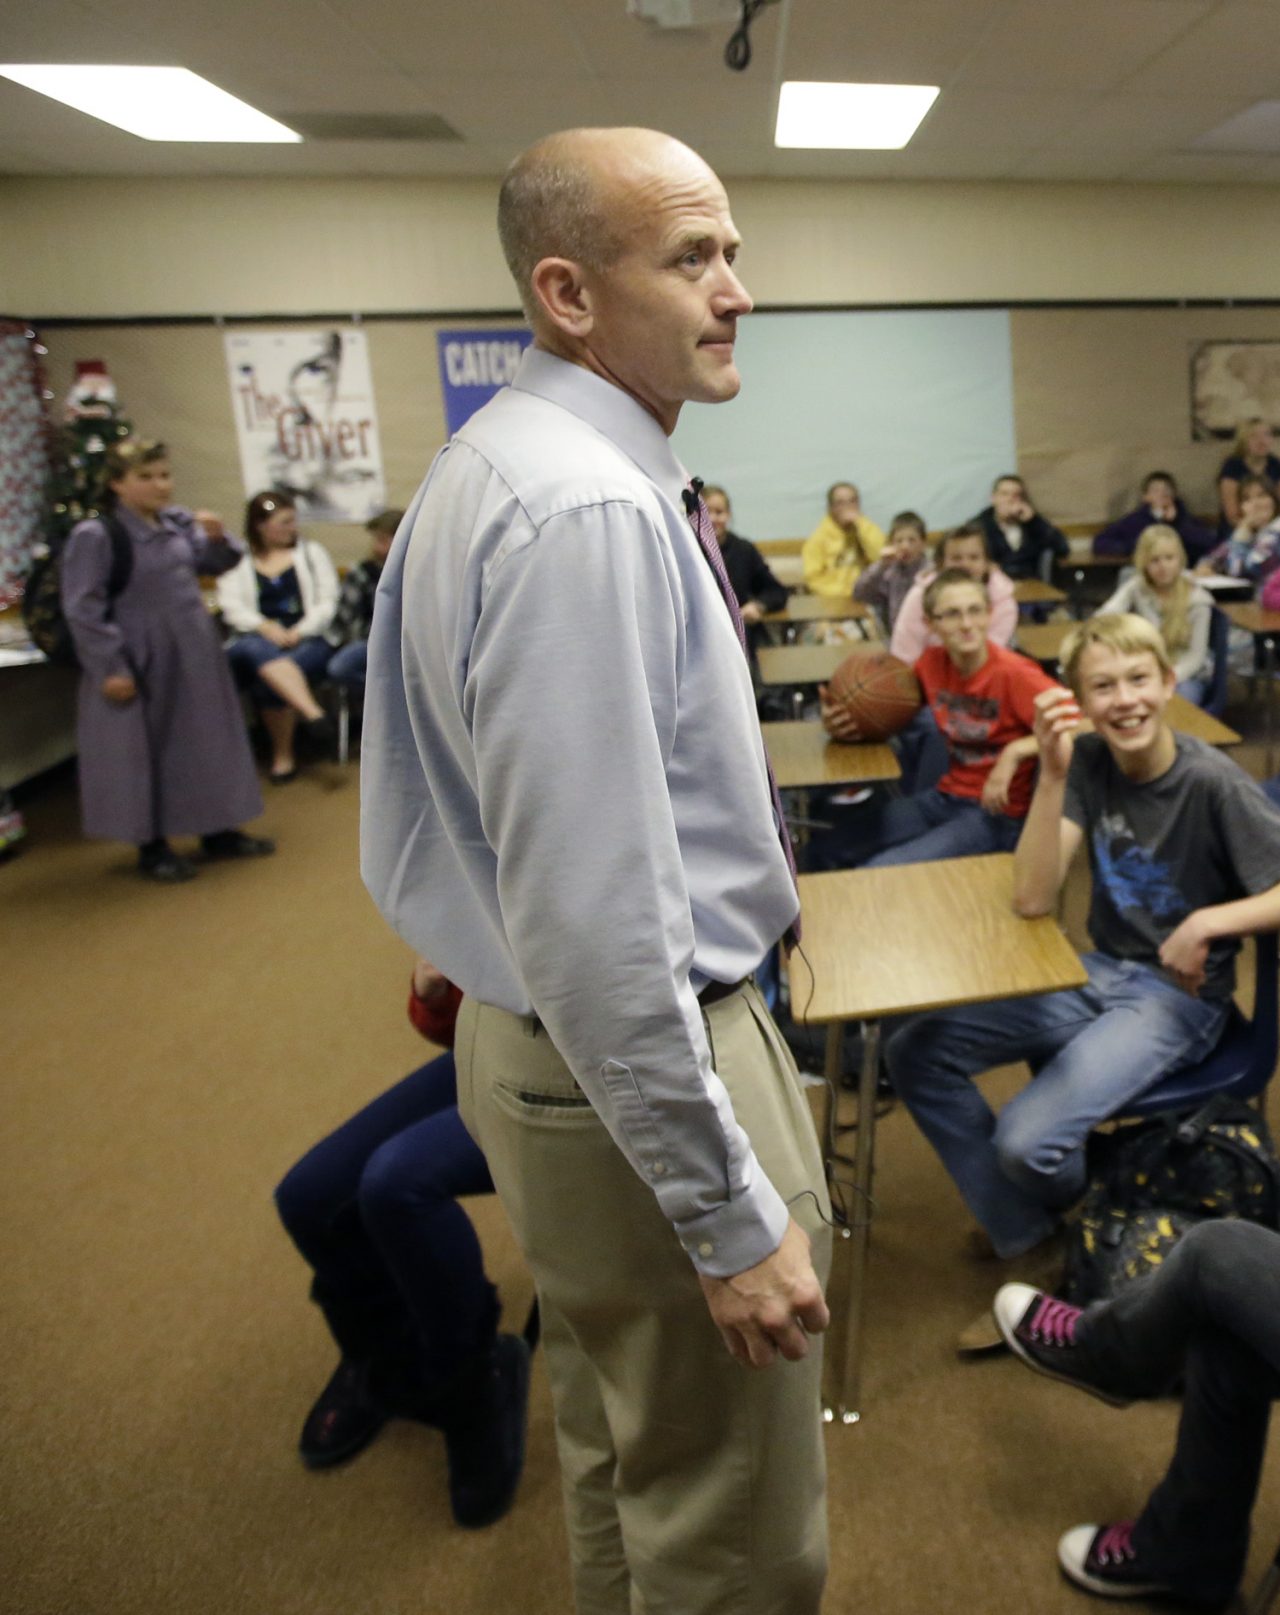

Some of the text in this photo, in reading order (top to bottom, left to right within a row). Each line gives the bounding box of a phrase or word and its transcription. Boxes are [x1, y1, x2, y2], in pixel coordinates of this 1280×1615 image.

[446, 341, 520, 386] CATCH
[239, 374, 282, 432] The
[277, 405, 371, 461] Giver
